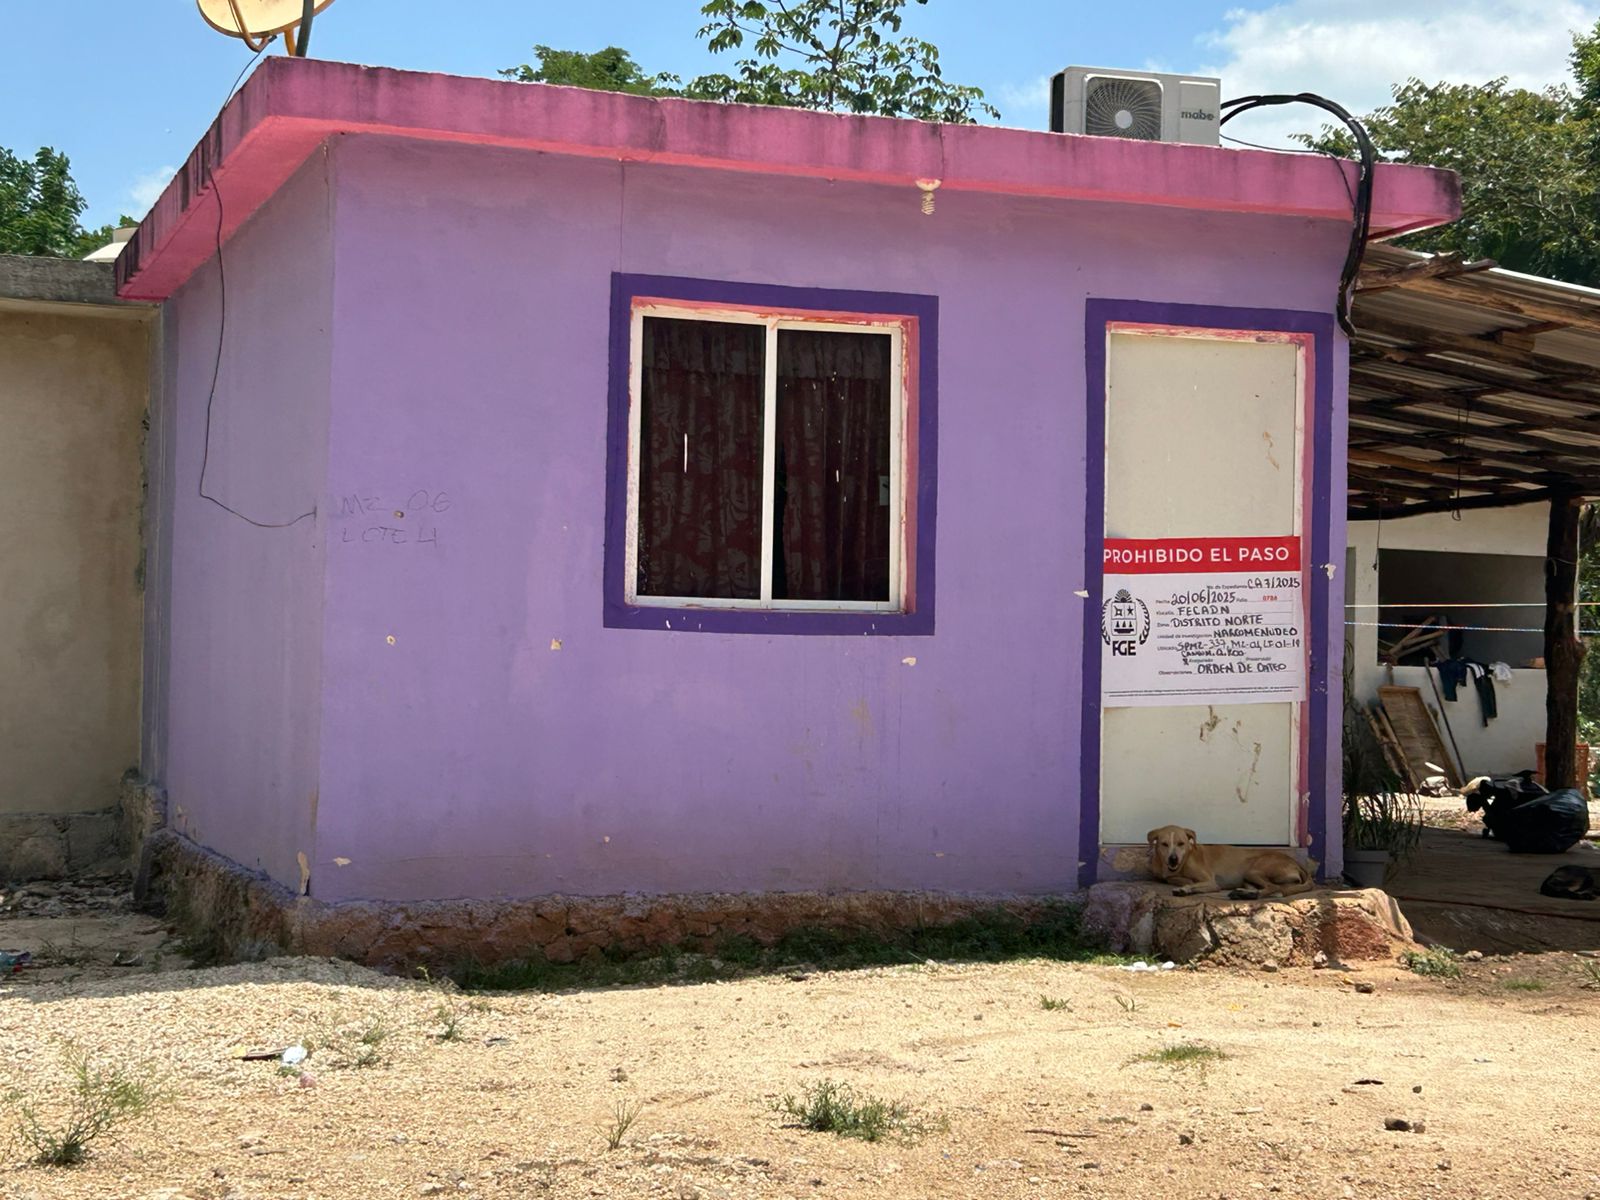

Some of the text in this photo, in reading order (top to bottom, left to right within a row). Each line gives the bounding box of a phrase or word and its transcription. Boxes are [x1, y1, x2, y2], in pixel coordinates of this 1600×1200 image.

[1181, 109, 1214, 120] mabe
[1103, 546, 1290, 564] PROHIBIDO EL PASO
[1171, 617, 1220, 628] DISTRITO
[1225, 614, 1263, 626] NORTE
[1112, 640, 1137, 656] FGE
[1197, 662, 1234, 674] ORDEN
[1236, 661, 1253, 674] DE
